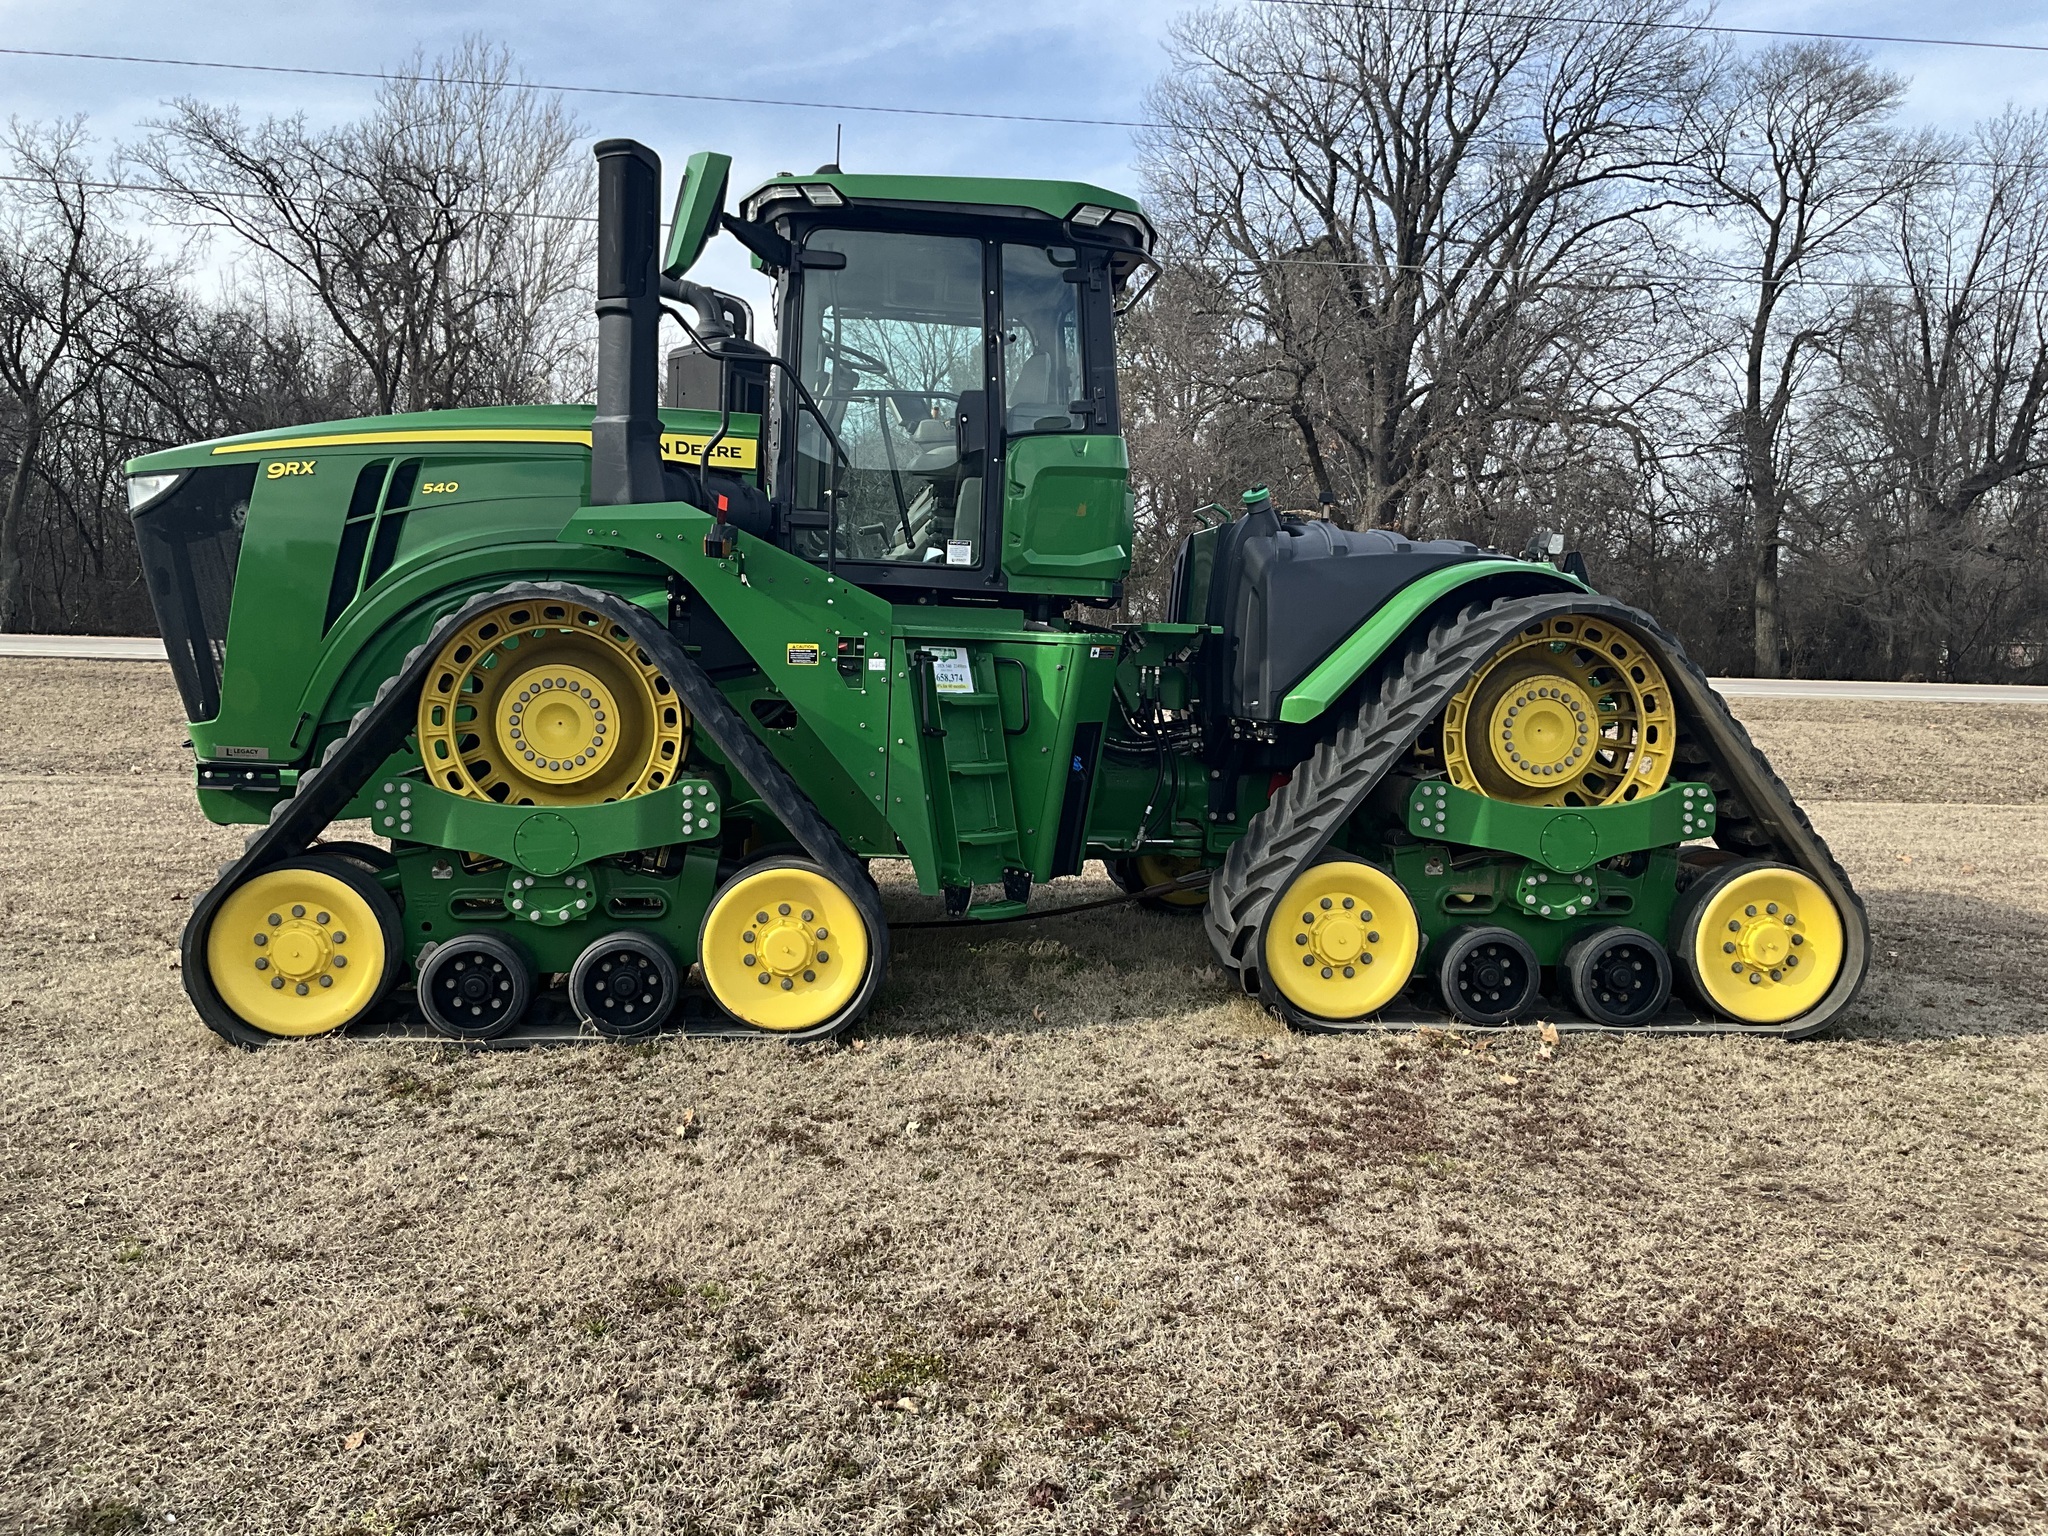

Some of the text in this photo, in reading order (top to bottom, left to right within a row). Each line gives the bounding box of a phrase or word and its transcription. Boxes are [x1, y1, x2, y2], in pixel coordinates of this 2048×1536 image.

[266, 460, 317, 480] 9RX
[421, 481, 460, 495] 540
[936, 673, 963, 683] 658,374
